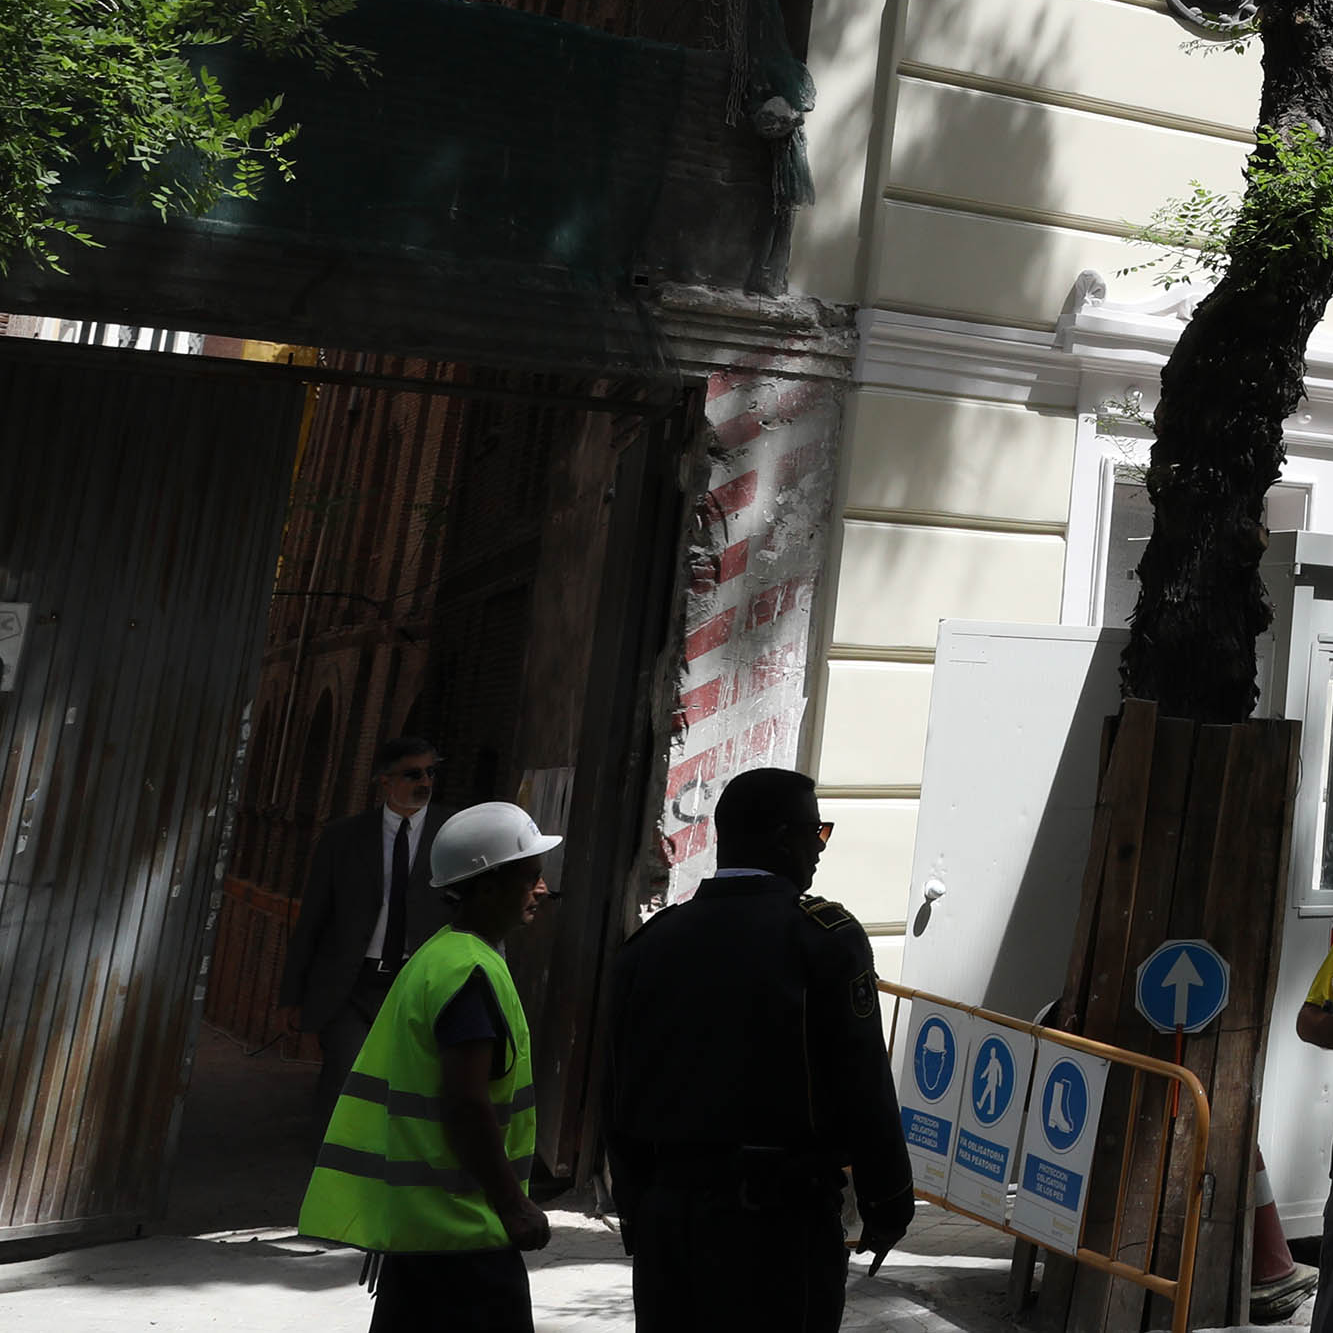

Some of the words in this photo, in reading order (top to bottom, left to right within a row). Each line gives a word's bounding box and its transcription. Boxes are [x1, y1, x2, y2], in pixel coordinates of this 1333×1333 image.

[958, 1148, 971, 1163] PARA
[971, 1153, 1001, 1174] PEATONES
[968, 1141, 1004, 1162] OBLIGATORIA
